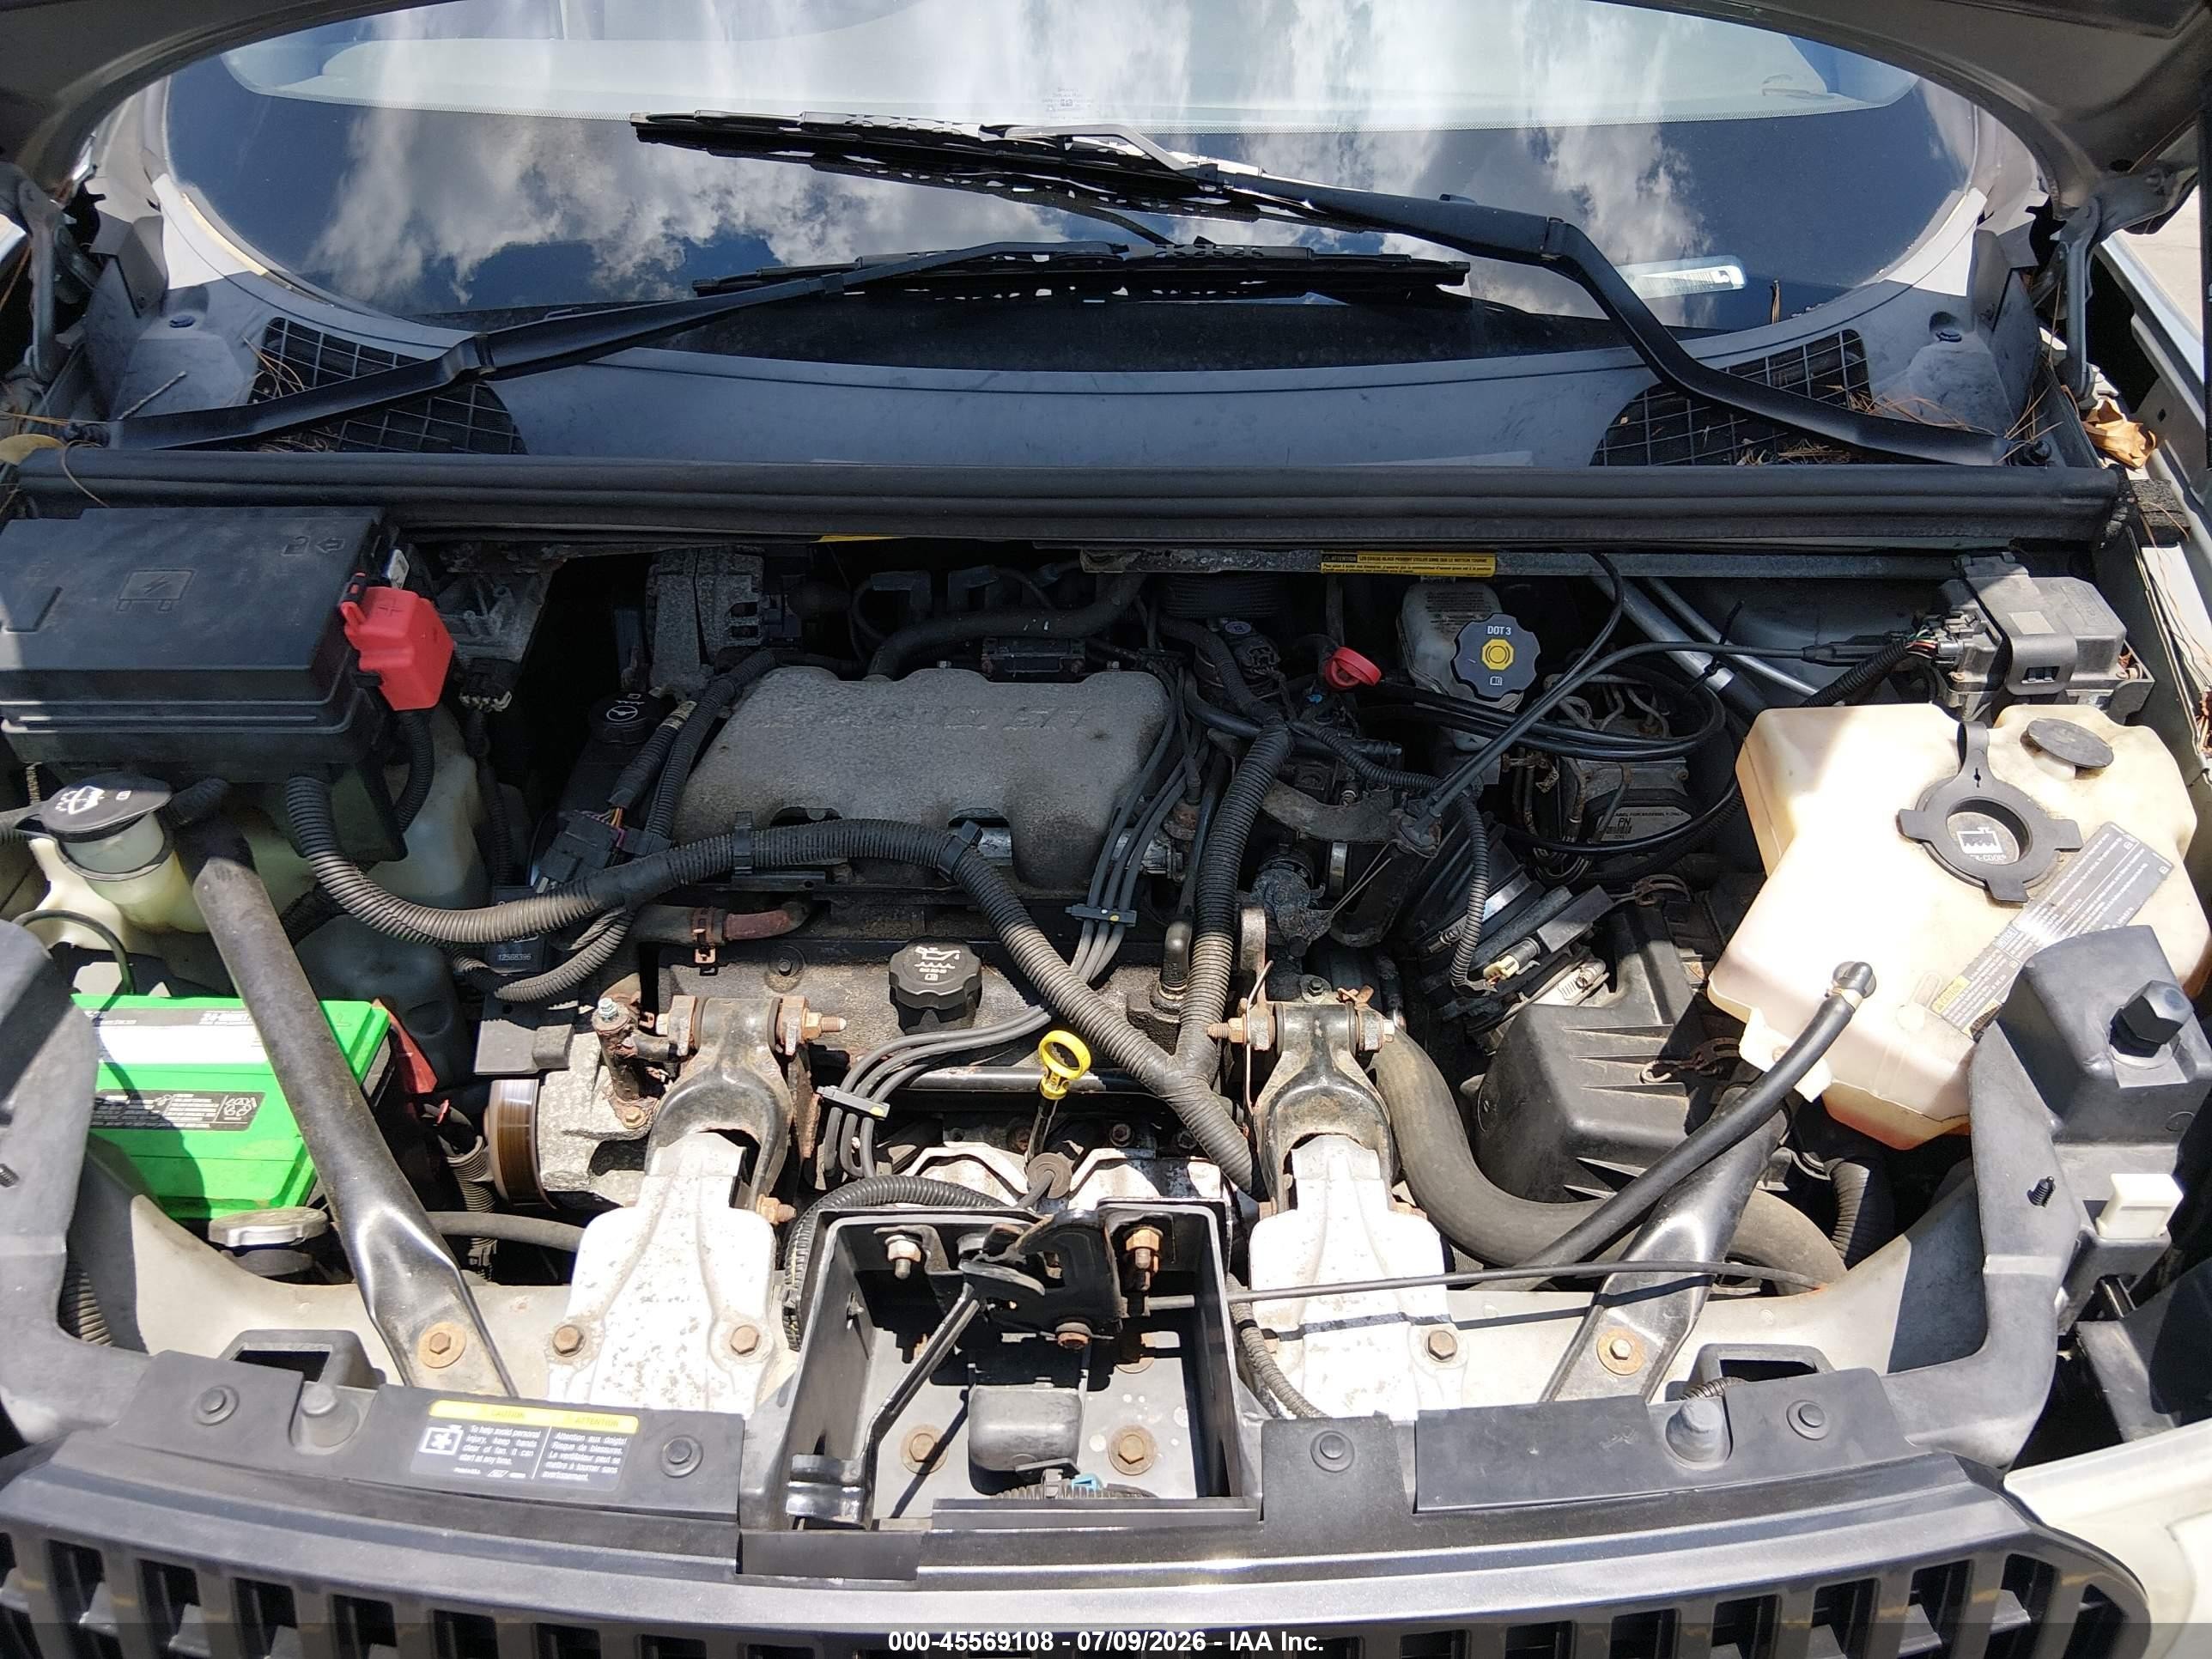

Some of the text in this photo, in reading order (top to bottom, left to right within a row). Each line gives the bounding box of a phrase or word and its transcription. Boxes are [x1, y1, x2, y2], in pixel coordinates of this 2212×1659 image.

[1486, 625, 1512, 635] DOT 3
[470, 1424, 479, 1433] To
[479, 1425, 494, 1435] help
[512, 1430, 542, 1439] personal
[554, 1431, 586, 1442] Attention
[493, 1437, 511, 1445] keep
[462, 1443, 481, 1452] clear
[483, 1456, 496, 1465] any
[548, 1450, 558, 1459] Le
[594, 1456, 611, 1465] peut
